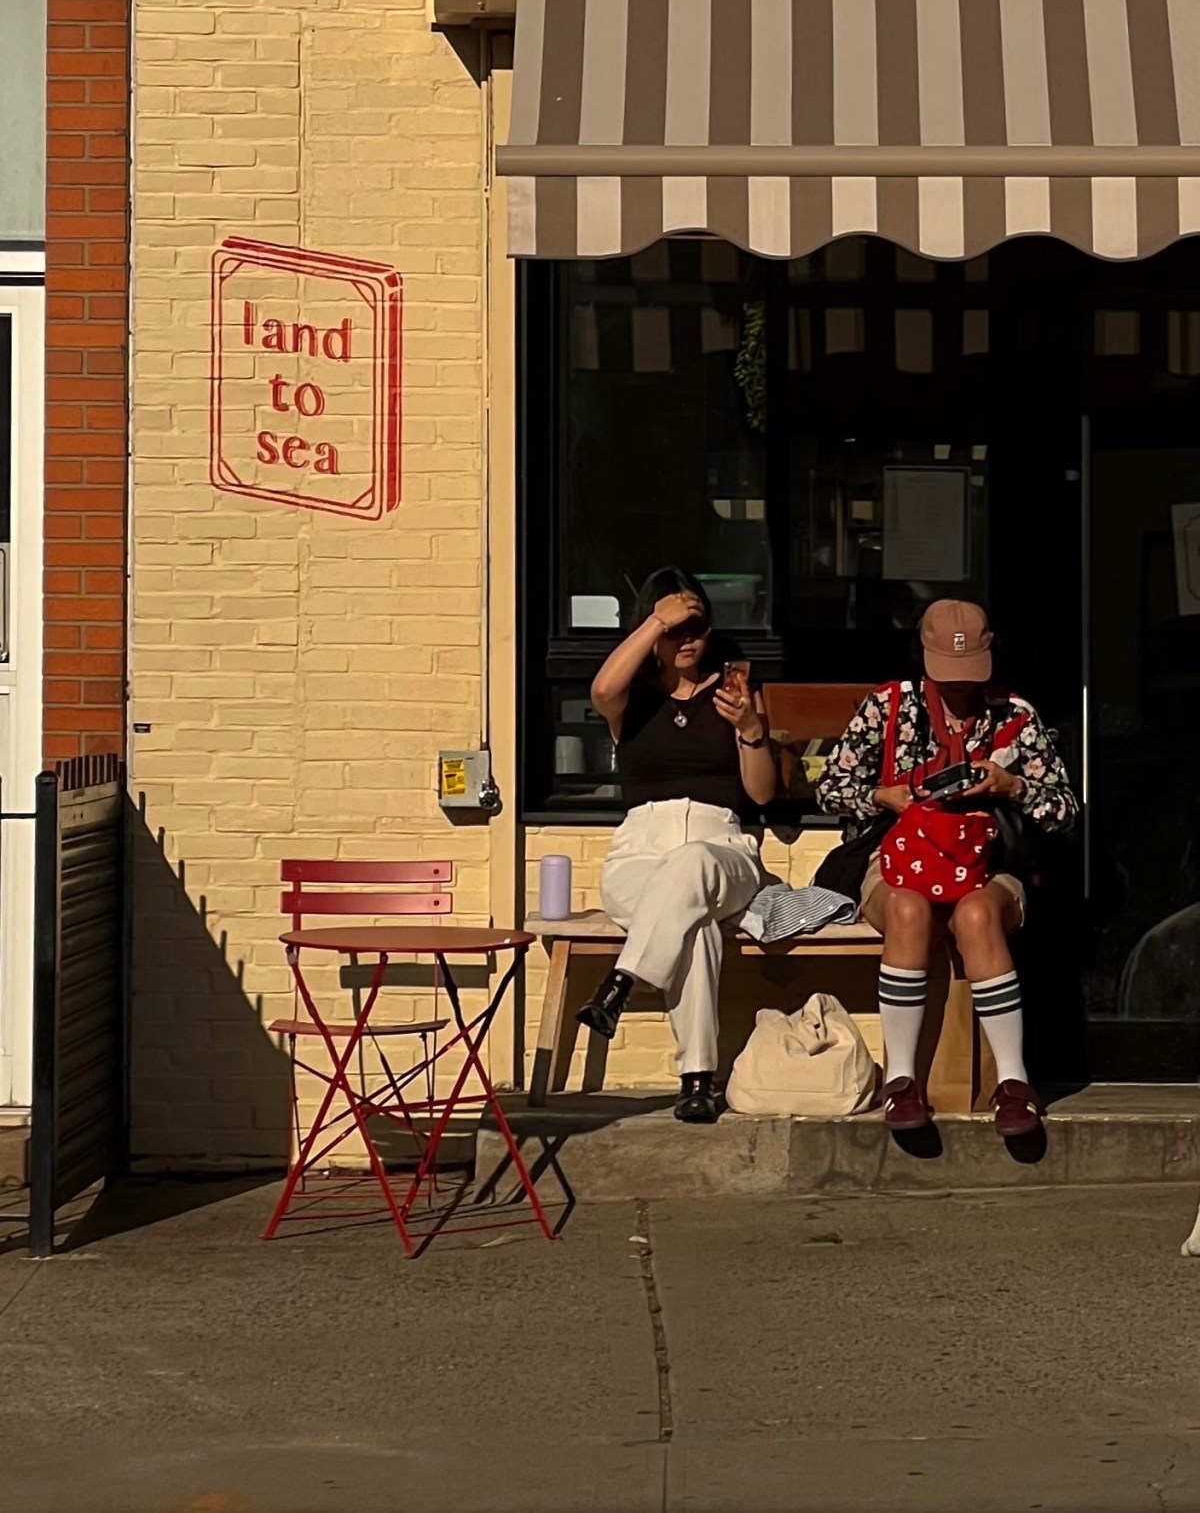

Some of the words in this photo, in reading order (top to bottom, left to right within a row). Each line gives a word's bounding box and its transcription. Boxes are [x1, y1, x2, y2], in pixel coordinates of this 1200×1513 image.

[244, 301, 352, 363] land
[268, 373, 325, 417] to
[256, 430, 340, 475] sea
[955, 866, 967, 882] 9
